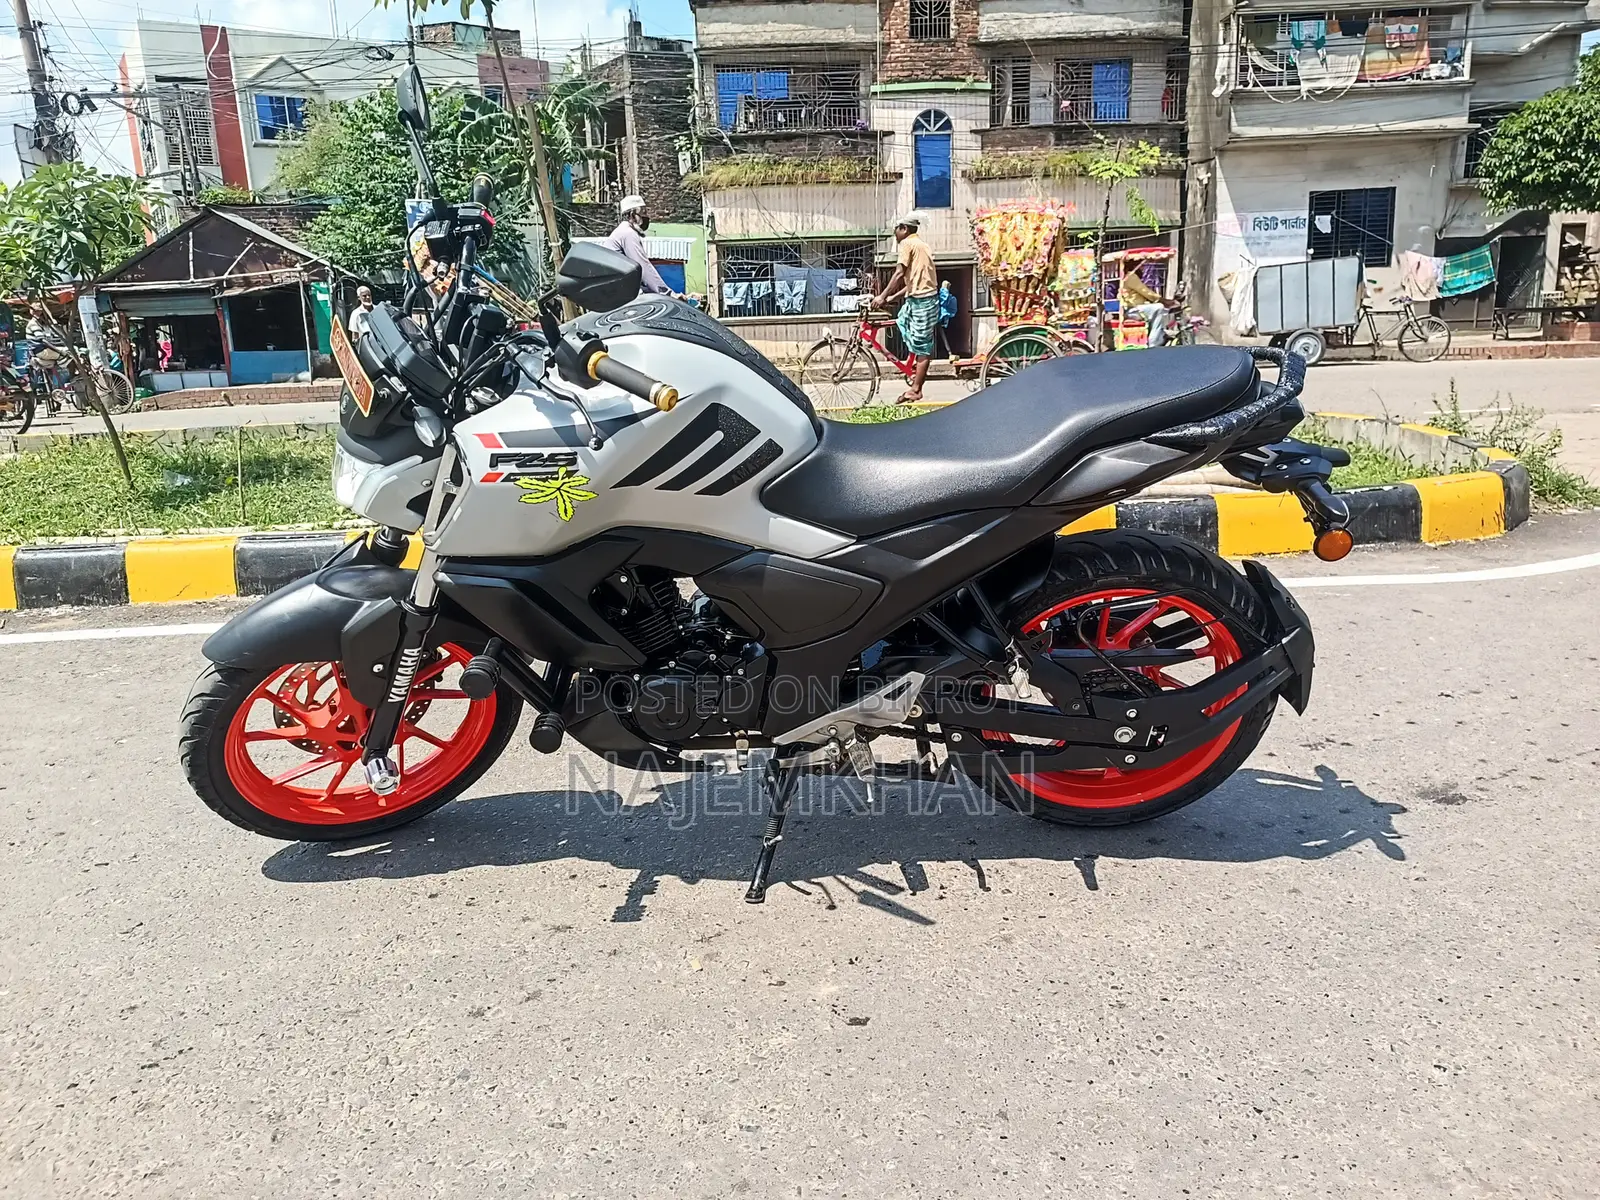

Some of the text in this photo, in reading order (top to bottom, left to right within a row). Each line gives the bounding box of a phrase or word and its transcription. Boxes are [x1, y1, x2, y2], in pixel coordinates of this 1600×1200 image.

[1252, 216, 1279, 231] বিউটি
[1280, 216, 1307, 230] পার্লার
[489, 451, 578, 470] FZS
[388, 647, 422, 703] YAMAHA
